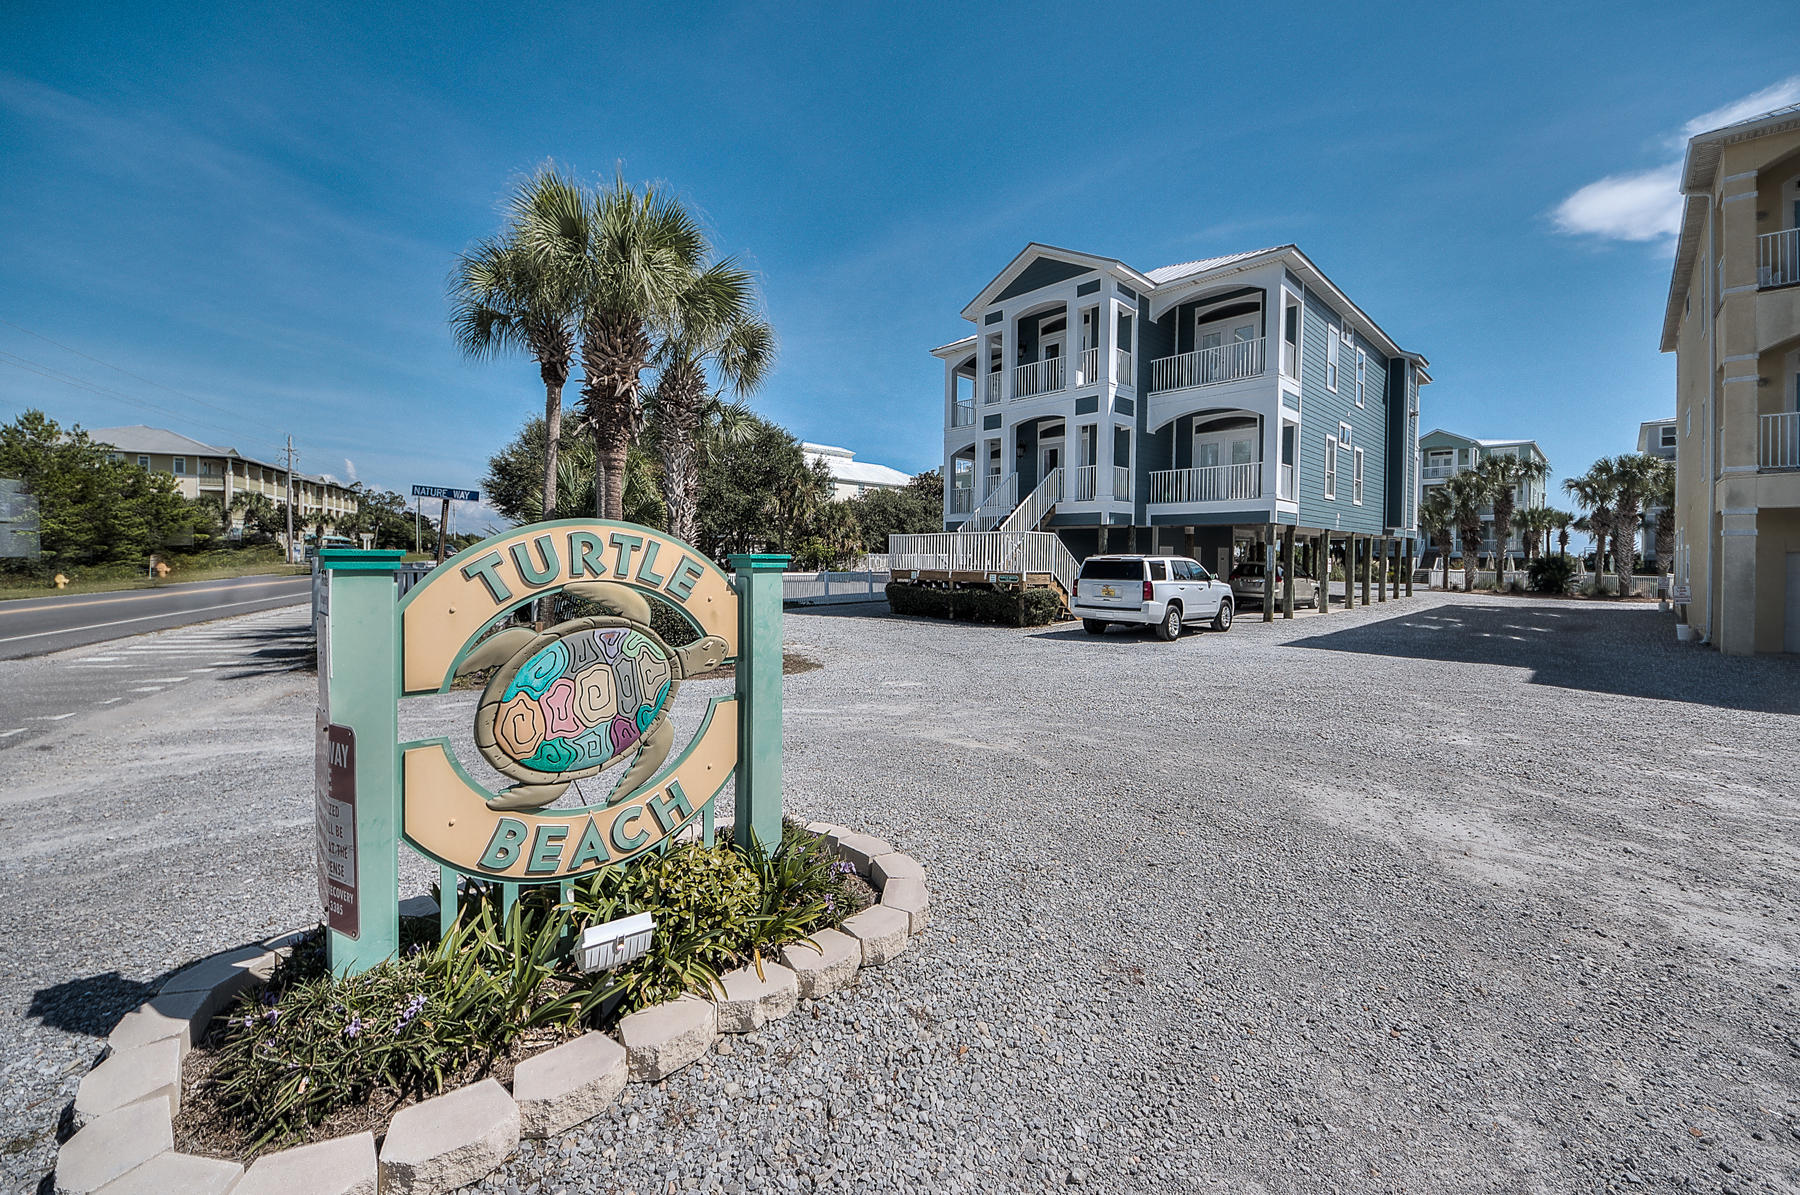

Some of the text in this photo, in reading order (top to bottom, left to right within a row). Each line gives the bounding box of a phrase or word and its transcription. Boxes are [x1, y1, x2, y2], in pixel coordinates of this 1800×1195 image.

[413, 486, 470, 500] NATURE WAY
[459, 530, 705, 606] TURTLE
[335, 824, 344, 839] BE
[476, 776, 695, 877] BEACH
